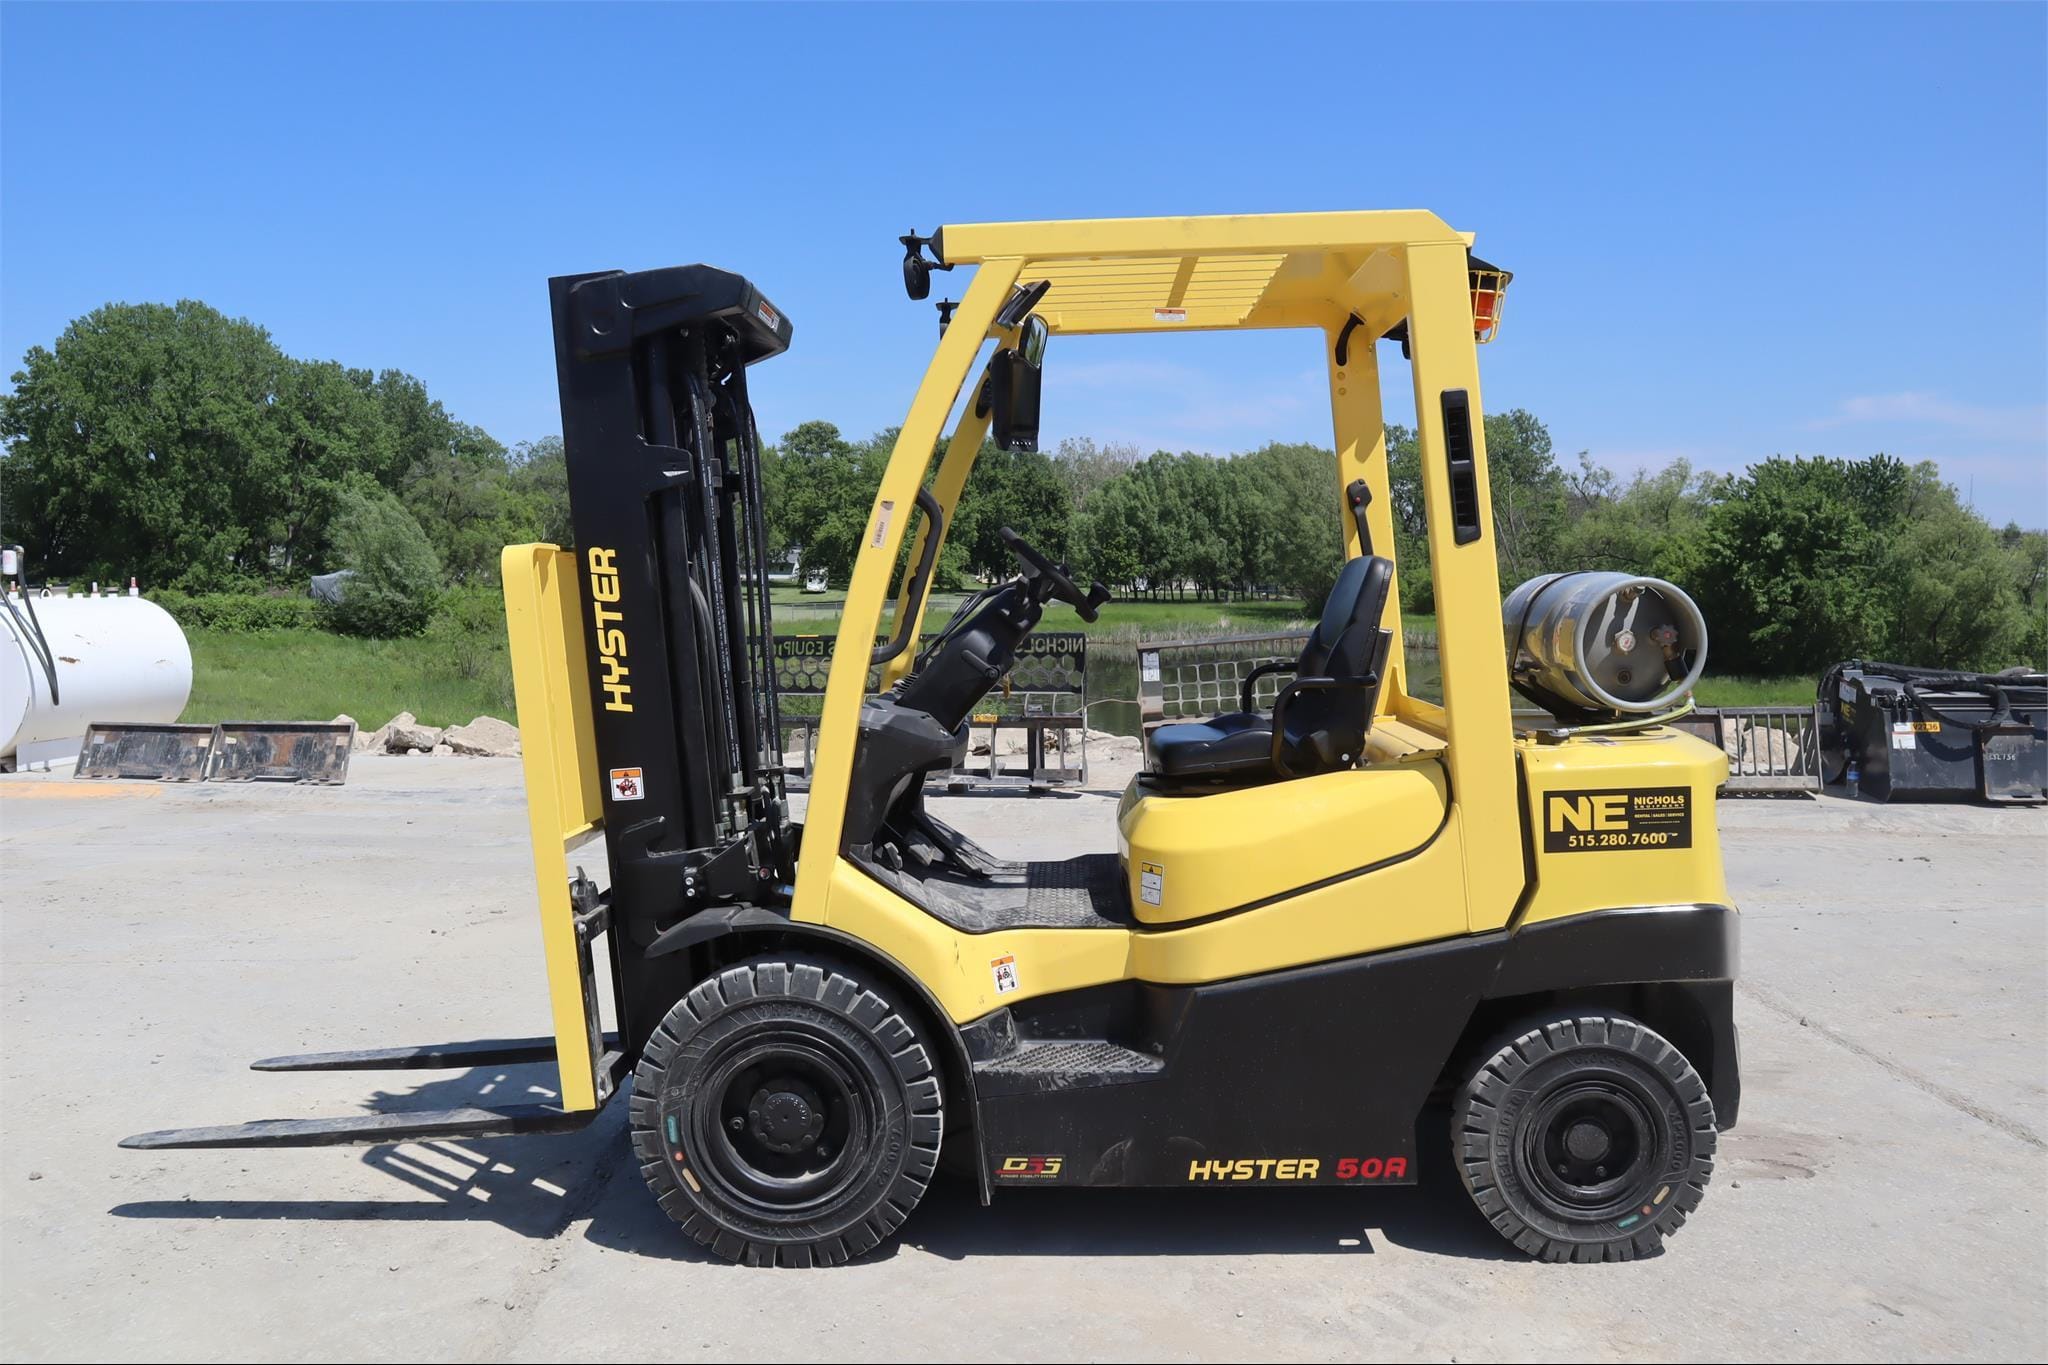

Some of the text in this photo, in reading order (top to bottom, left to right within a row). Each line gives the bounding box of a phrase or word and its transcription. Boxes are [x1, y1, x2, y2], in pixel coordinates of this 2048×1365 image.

[588, 547, 633, 712] HYSTER
[1634, 795, 1685, 805] NICHOLS
[1550, 795, 1628, 832] NE
[1568, 832, 1667, 847] 515.280.7600
[1188, 1158, 1320, 1181] HYSTER
